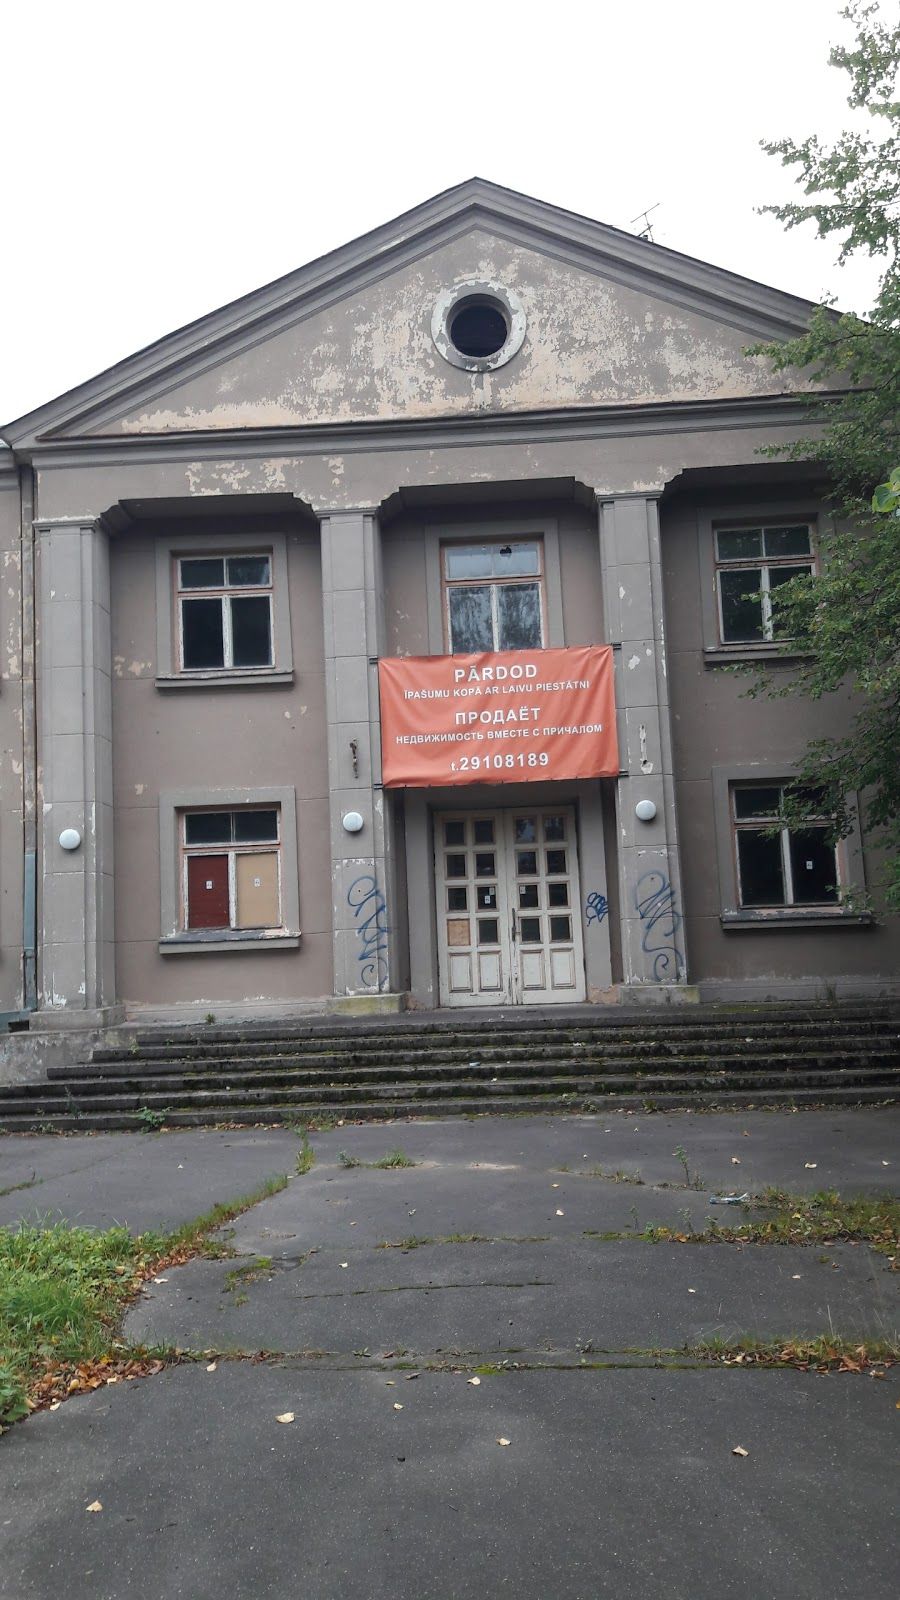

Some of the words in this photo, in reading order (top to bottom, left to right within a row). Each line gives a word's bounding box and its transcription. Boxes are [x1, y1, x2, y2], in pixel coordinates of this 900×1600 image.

[454, 664, 537, 682] PĀRDOD
[404, 689, 450, 699] ĪPAŠUMU
[453, 686, 482, 697] KOPĀ
[485, 686, 499, 695] AR
[502, 684, 532, 694] LAIVU
[536, 680, 590, 692] PIESTĀTNI
[455, 706, 541, 725] ПРОДАЁТ
[396, 731, 484, 745] НЕДВИЖИМОСТЬ
[487, 729, 529, 739] ВМЕСТЕ
[532, 728, 540, 736] С
[543, 724, 602, 736] ПРИЧАЛОМ
